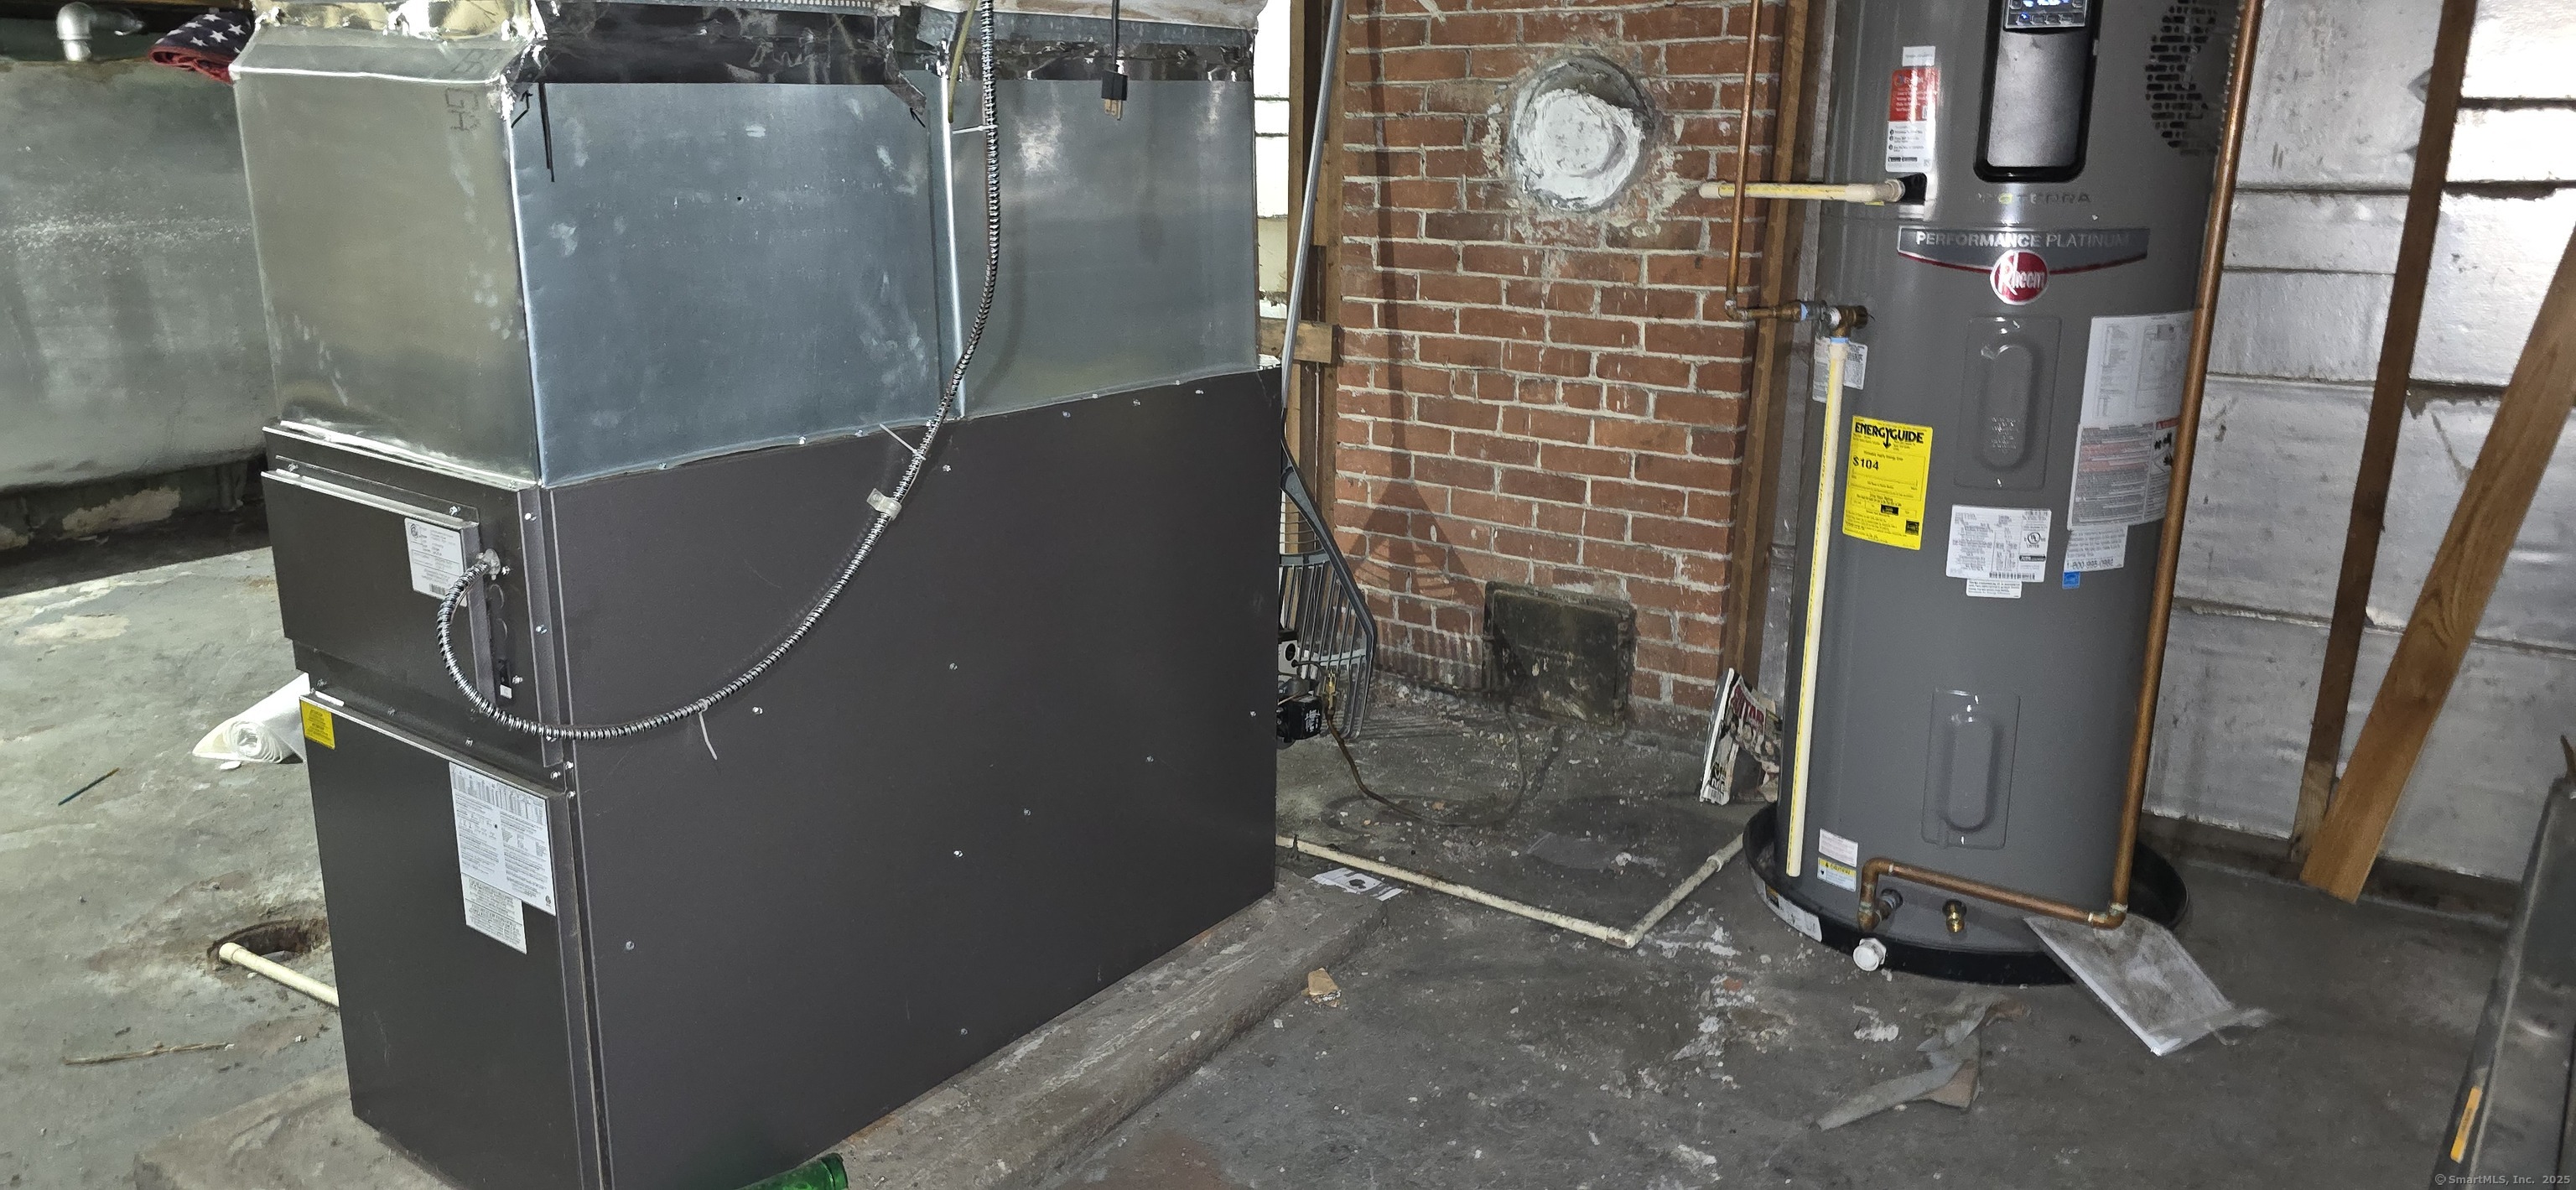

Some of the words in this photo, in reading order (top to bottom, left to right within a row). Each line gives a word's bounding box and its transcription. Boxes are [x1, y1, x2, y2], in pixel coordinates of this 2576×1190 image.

[1916, 231, 2041, 249] PERFORMANCE
[2046, 232, 2130, 249] PLATINUM
[1997, 252, 2046, 296] Rheem
[1855, 422, 1924, 444] ENERGYGUIDE
